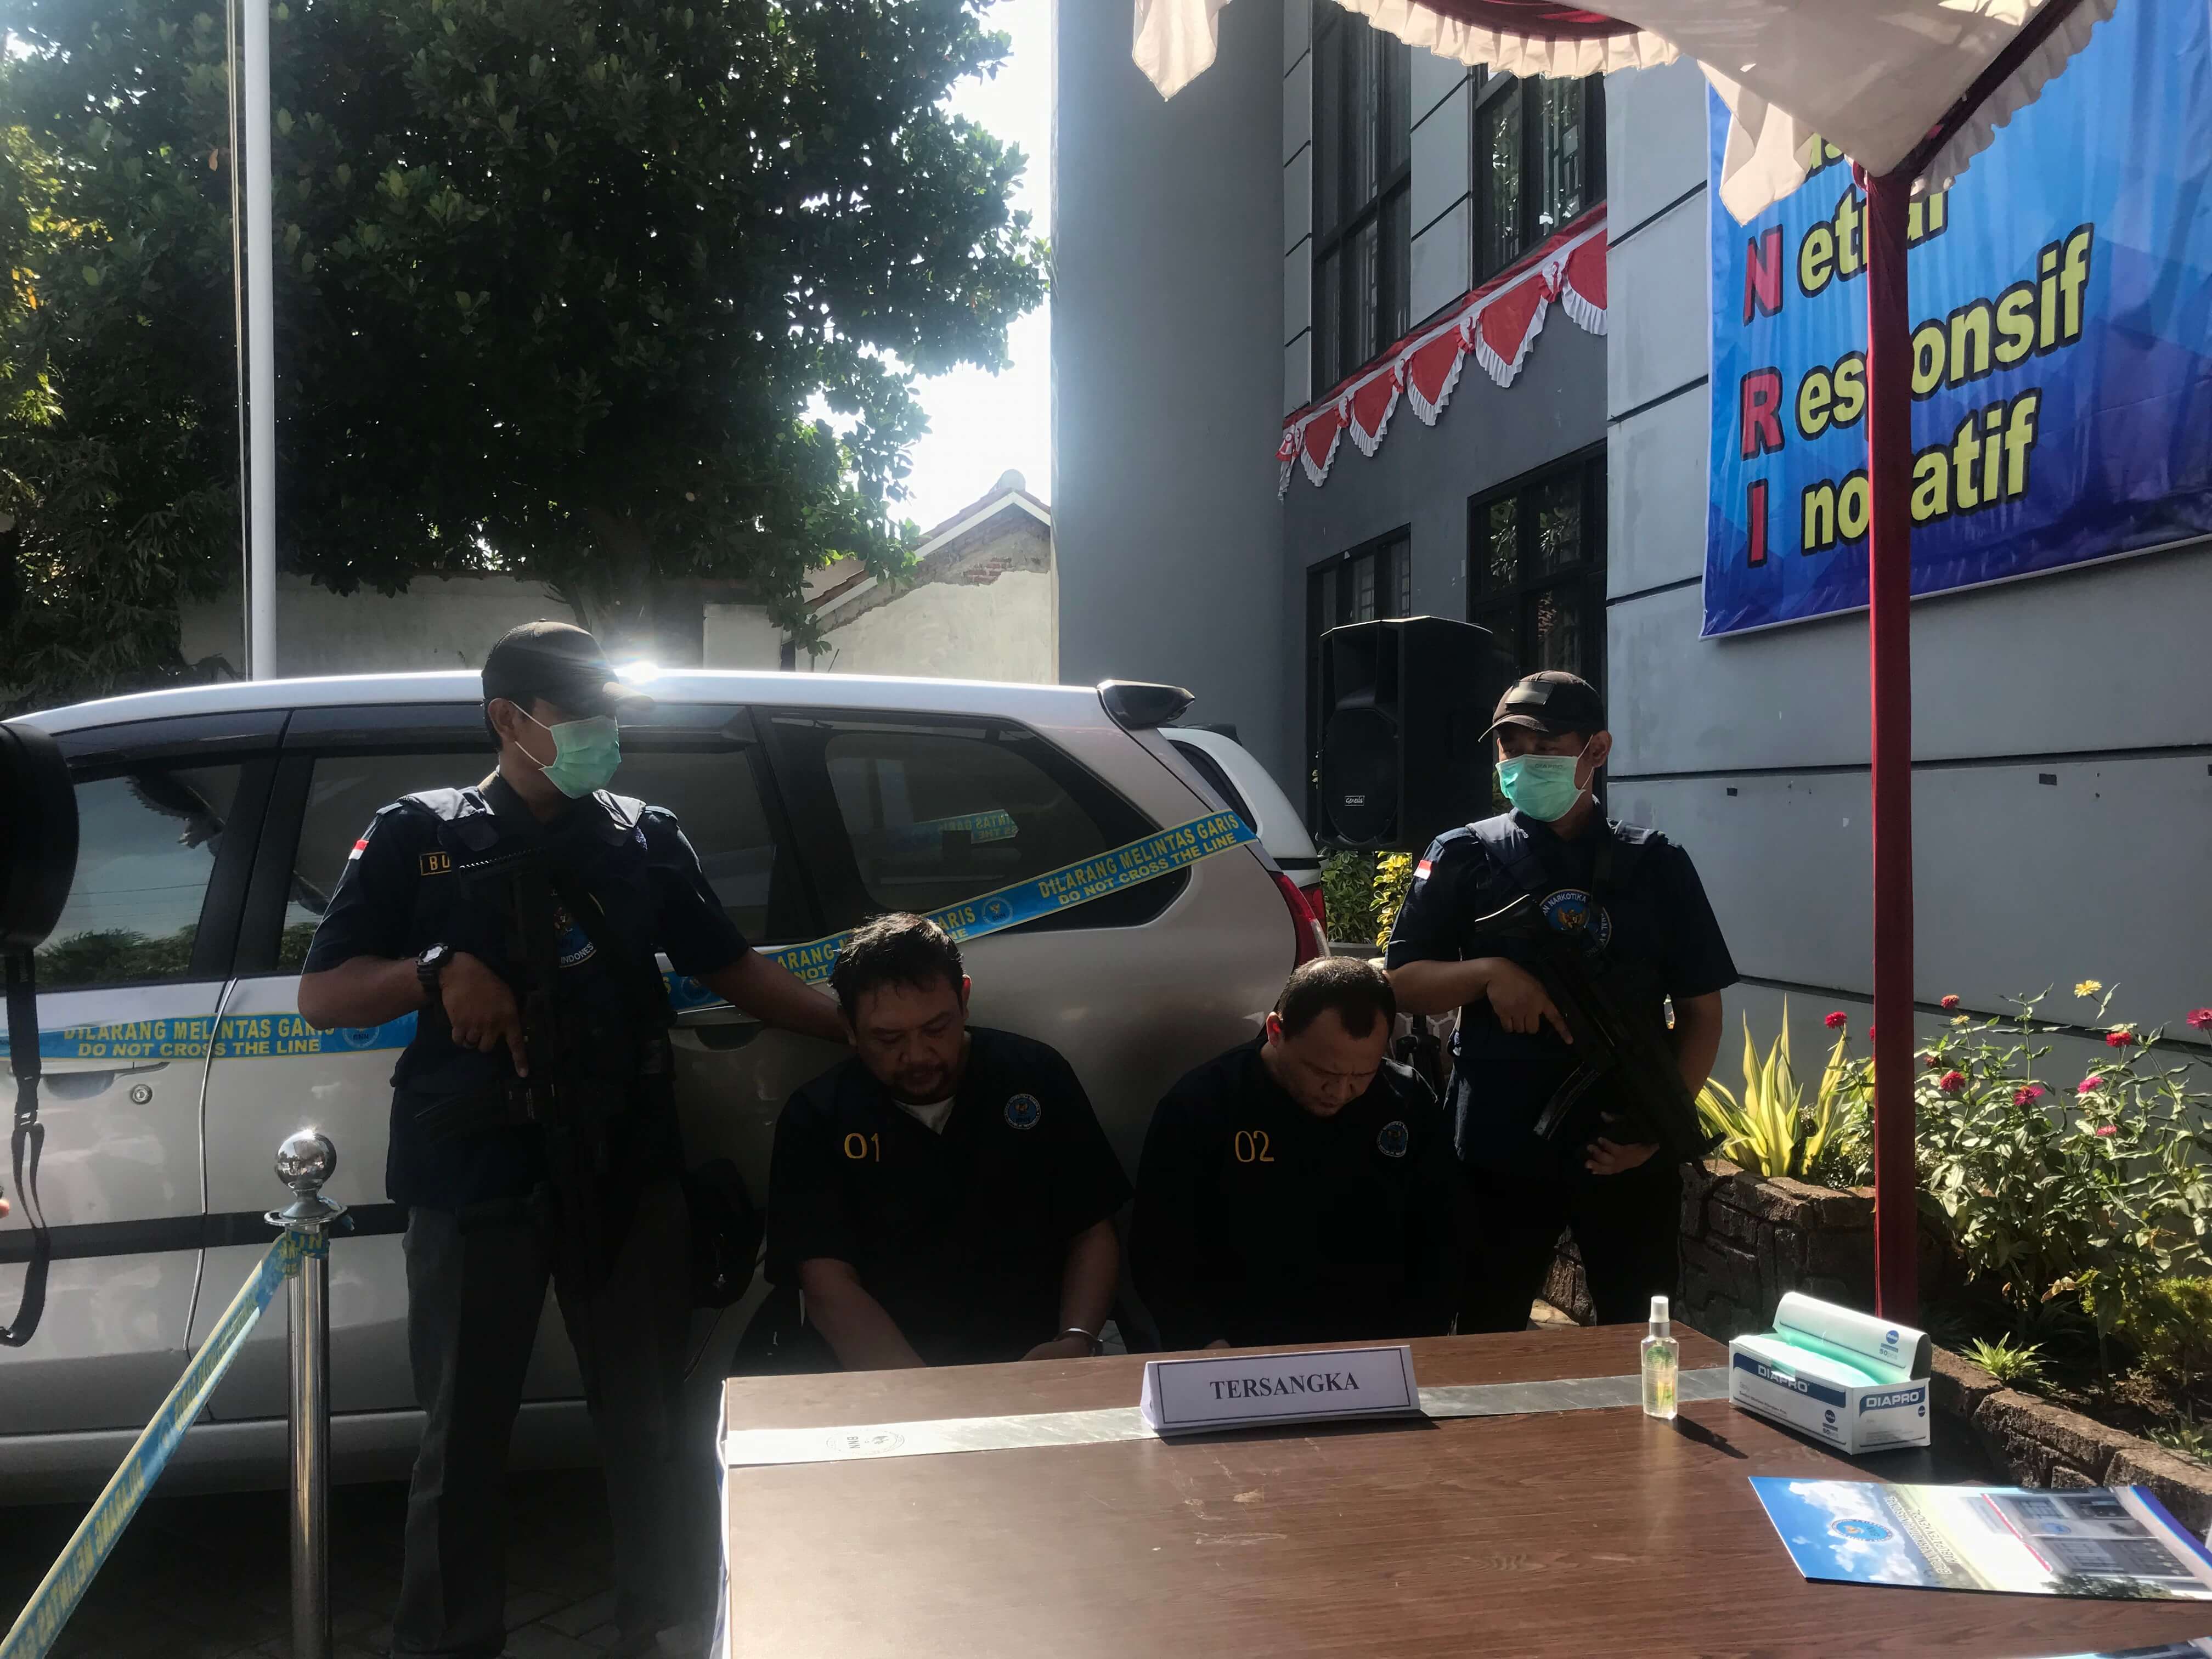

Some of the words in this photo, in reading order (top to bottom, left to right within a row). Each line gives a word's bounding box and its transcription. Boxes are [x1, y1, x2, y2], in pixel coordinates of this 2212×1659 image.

[1740, 366, 1785, 460] R
[1798, 223, 2095, 440] esonsif
[1800, 388, 2042, 557] noatif
[1037, 857, 1118, 899] DILARANG
[1119, 827, 1195, 869] MELINTAS
[1197, 814, 1239, 839] GARIS
[1058, 890, 1081, 905] DO
[1084, 878, 1115, 896] NOT
[1119, 857, 1169, 884] CROSS
[1170, 845, 1201, 865] THE
[1202, 832, 1237, 853] LINE
[1548, 893, 1587, 907] NARKOTIKA
[560, 941, 595, 964] INDONES
[777, 943, 835, 972] ARANG
[938, 907, 975, 931] ARIS
[64, 1022, 166, 1040] DILARANG
[174, 1018, 272, 1040] MELNTAS
[78, 1043, 106, 1056] DO
[112, 1043, 154, 1056] NOT
[159, 1042, 227, 1057] CROSS
[232, 1041, 270, 1055] THE
[276, 1039, 320, 1054] LINE
[844, 1132, 880, 1163] 01
[1234, 1130, 1274, 1163] 02
[1209, 1372, 1360, 1400] TERSANGKA
[1758, 1364, 1808, 1393] DIAPRO
[1866, 1391, 1920, 1408] DIAPRO
